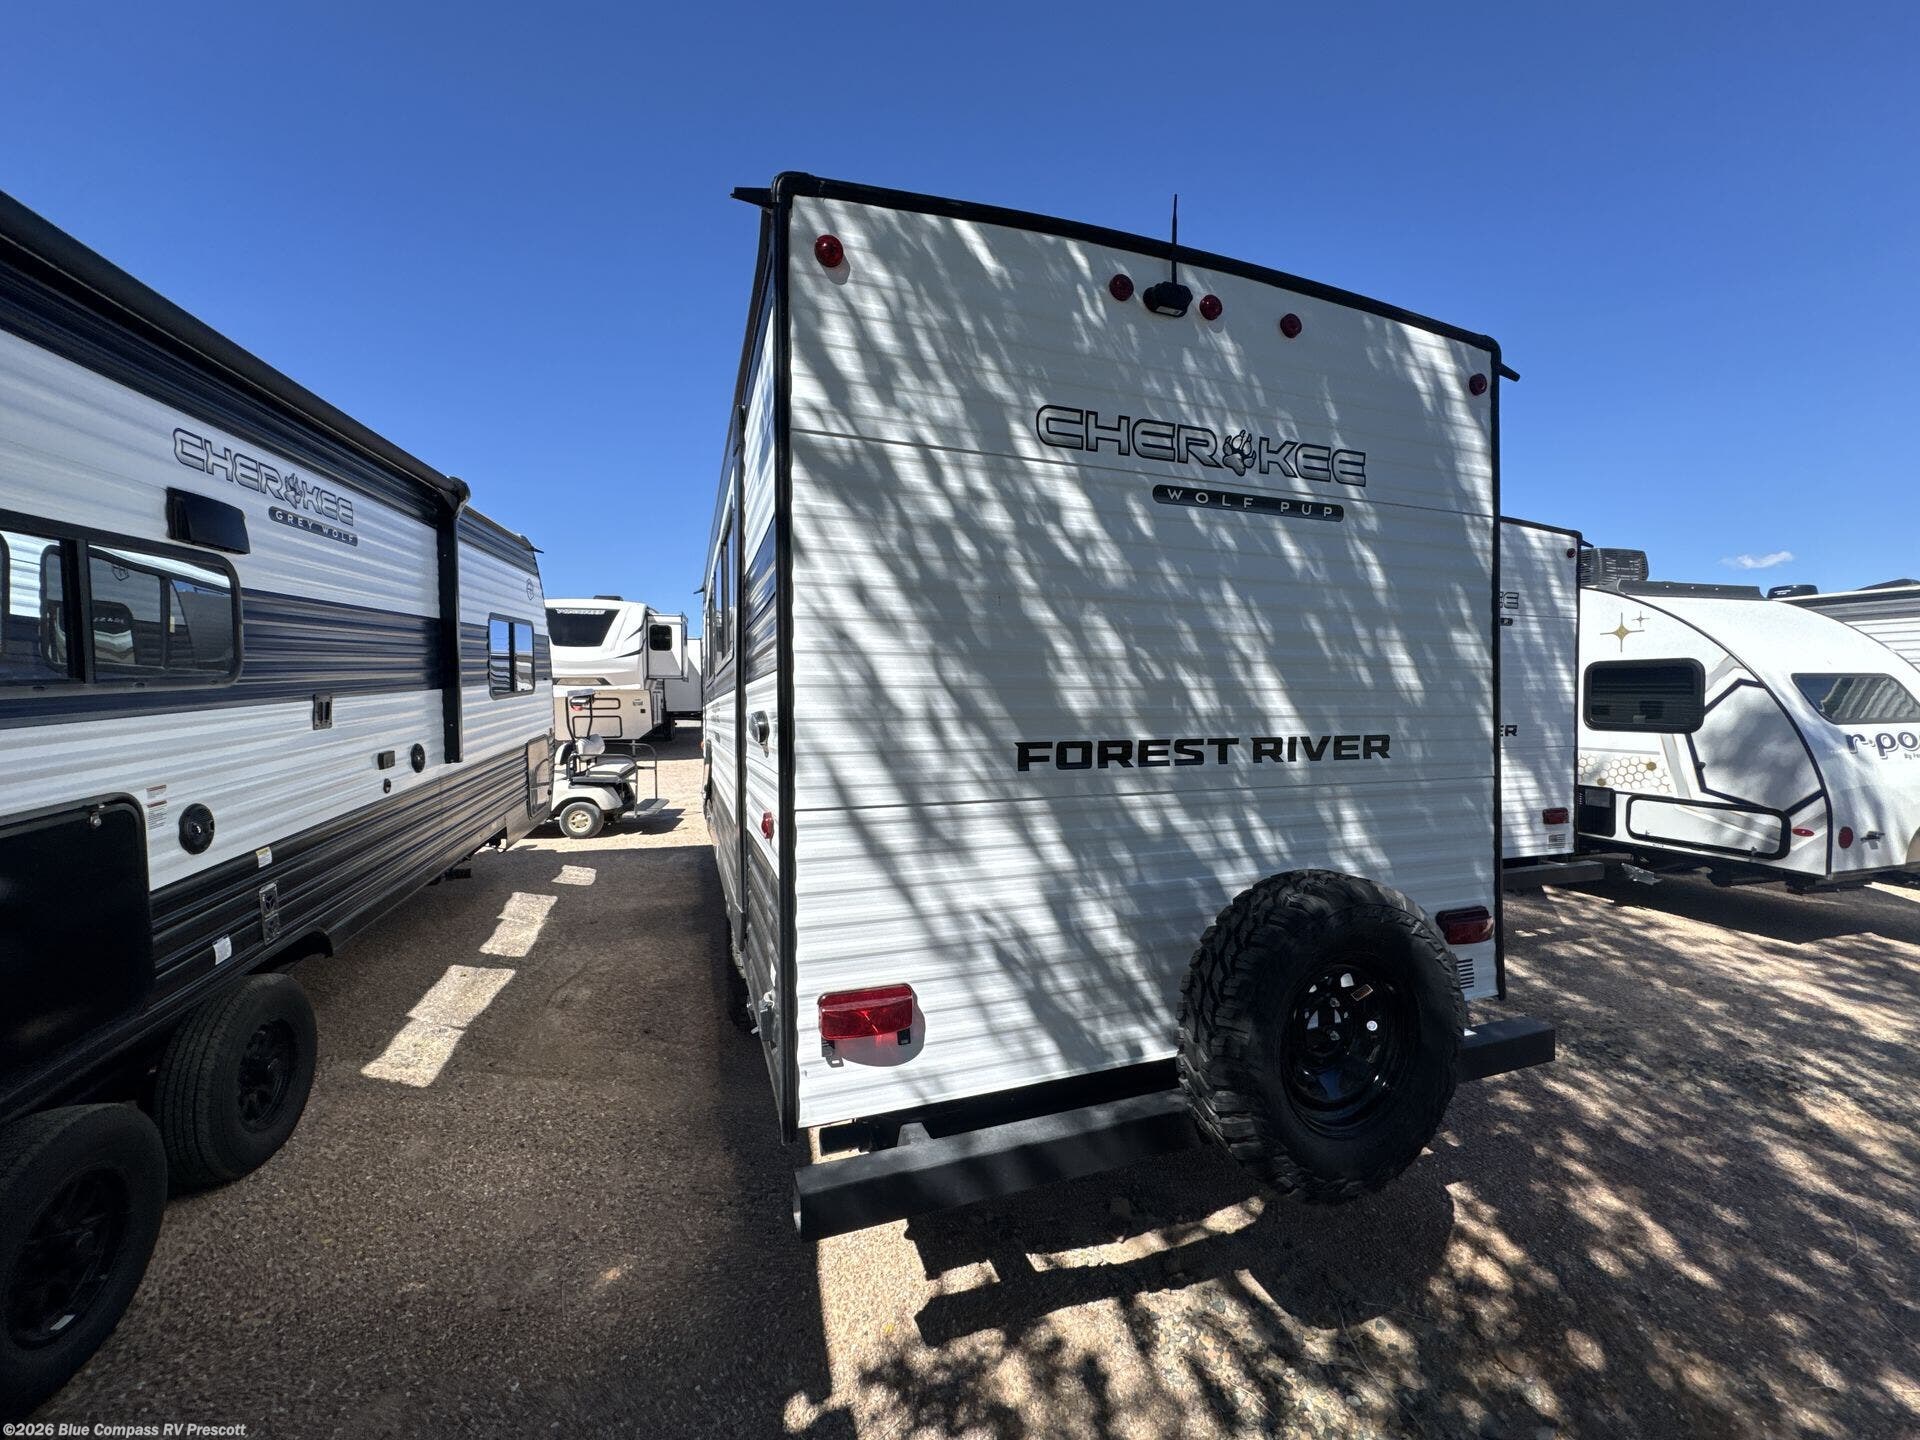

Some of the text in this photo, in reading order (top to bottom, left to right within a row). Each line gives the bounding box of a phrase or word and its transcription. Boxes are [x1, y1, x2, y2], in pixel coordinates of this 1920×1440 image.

[1167, 488, 1333, 517] WOLF PUP
[275, 510, 354, 544] GREY WOLF
[1014, 734, 1391, 771] FOREST RIVER
